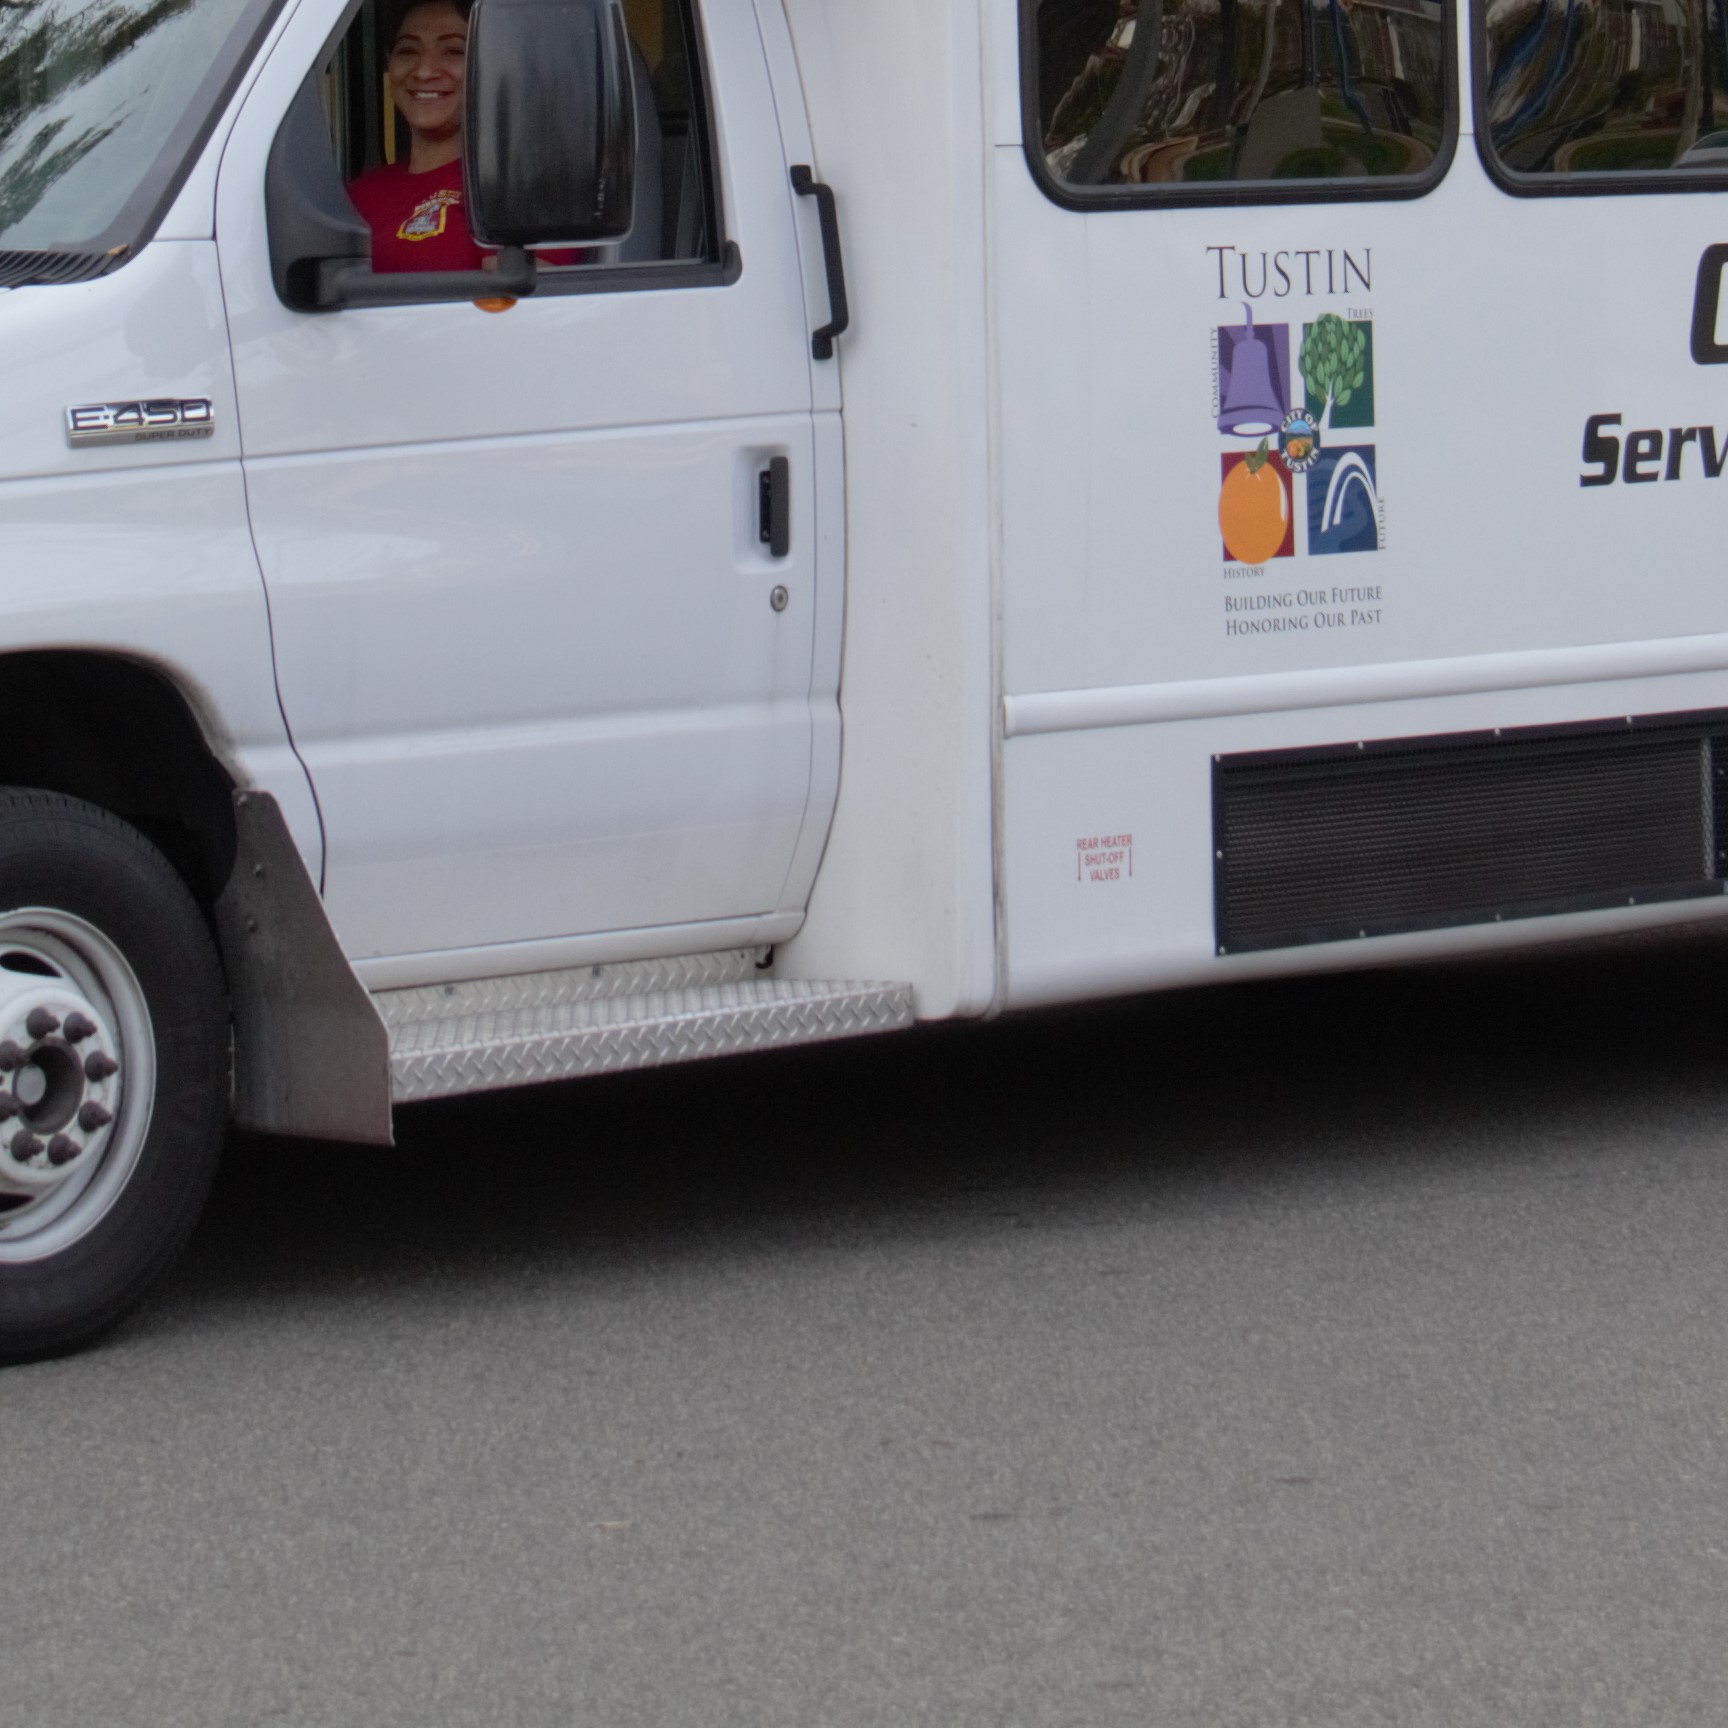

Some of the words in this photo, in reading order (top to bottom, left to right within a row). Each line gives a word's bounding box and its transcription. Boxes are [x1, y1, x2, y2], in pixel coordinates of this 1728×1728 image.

[135, 431, 174, 441] SUPER
[178, 428, 212, 438] DUTY
[1224, 593, 1293, 613] BUILDING
[1332, 586, 1382, 603] FUTURE
[1226, 614, 1309, 637] HONORING
[1077, 837, 1099, 850] REAR
[1101, 834, 1133, 849] HEATER
[1084, 851, 1125, 865] SHUT-OFF
[1090, 868, 1120, 882] VALVES
